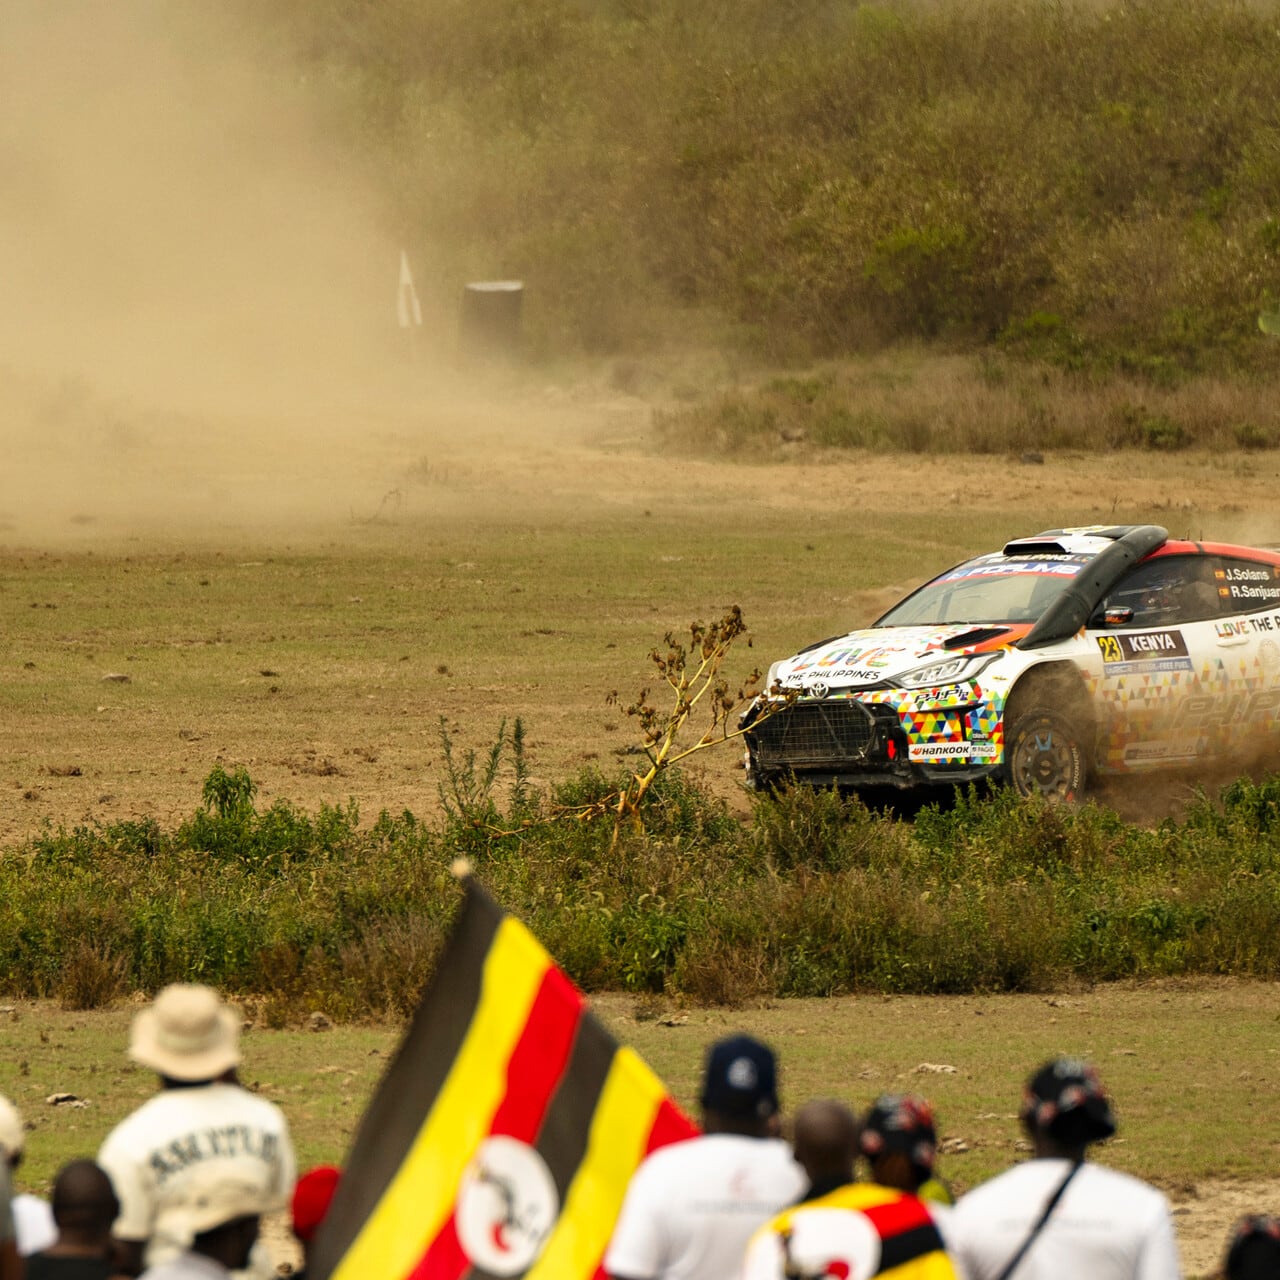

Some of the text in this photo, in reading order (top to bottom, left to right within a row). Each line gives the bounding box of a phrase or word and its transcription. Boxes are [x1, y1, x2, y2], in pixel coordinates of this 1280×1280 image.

[1226, 569, 1269, 581] J.Solans
[1214, 621, 1249, 638] LOVE
[1249, 616, 1273, 632] THE
[1099, 636, 1122, 662] 23
[1128, 633, 1177, 652] KENYA
[786, 670, 881, 683] THE PHILIPPINES
